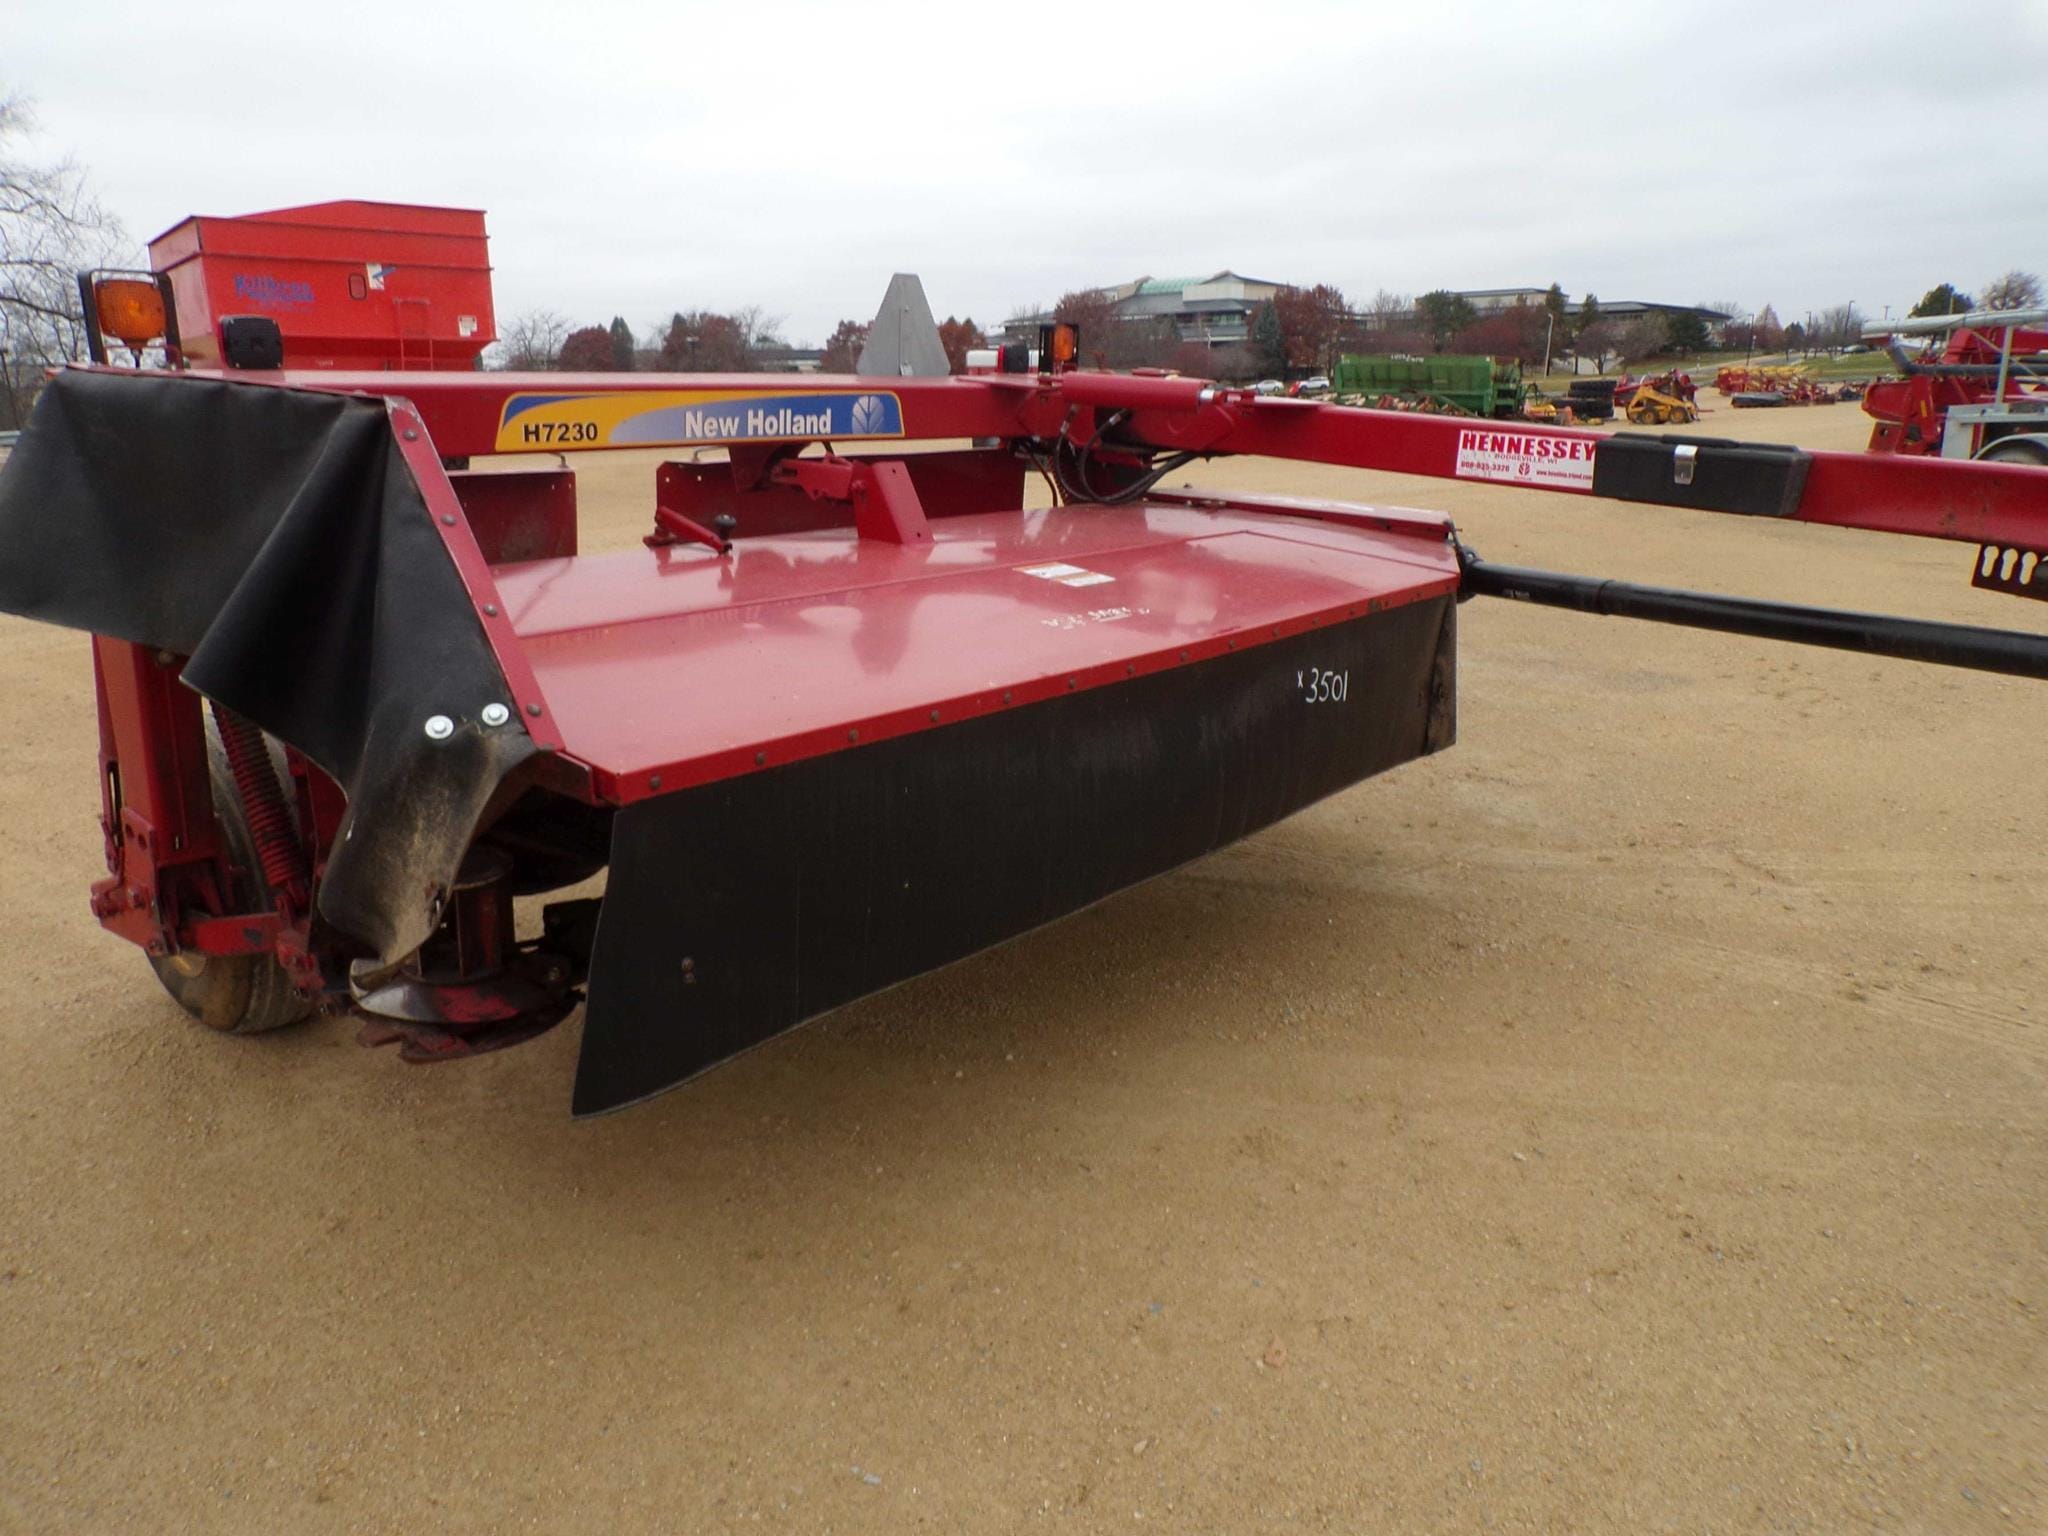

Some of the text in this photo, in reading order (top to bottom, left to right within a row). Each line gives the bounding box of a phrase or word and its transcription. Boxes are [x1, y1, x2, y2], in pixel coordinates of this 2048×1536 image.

[524, 423, 598, 443] H7230
[685, 408, 832, 438] New Holland
[1462, 432, 1596, 461] HENNESSEY
